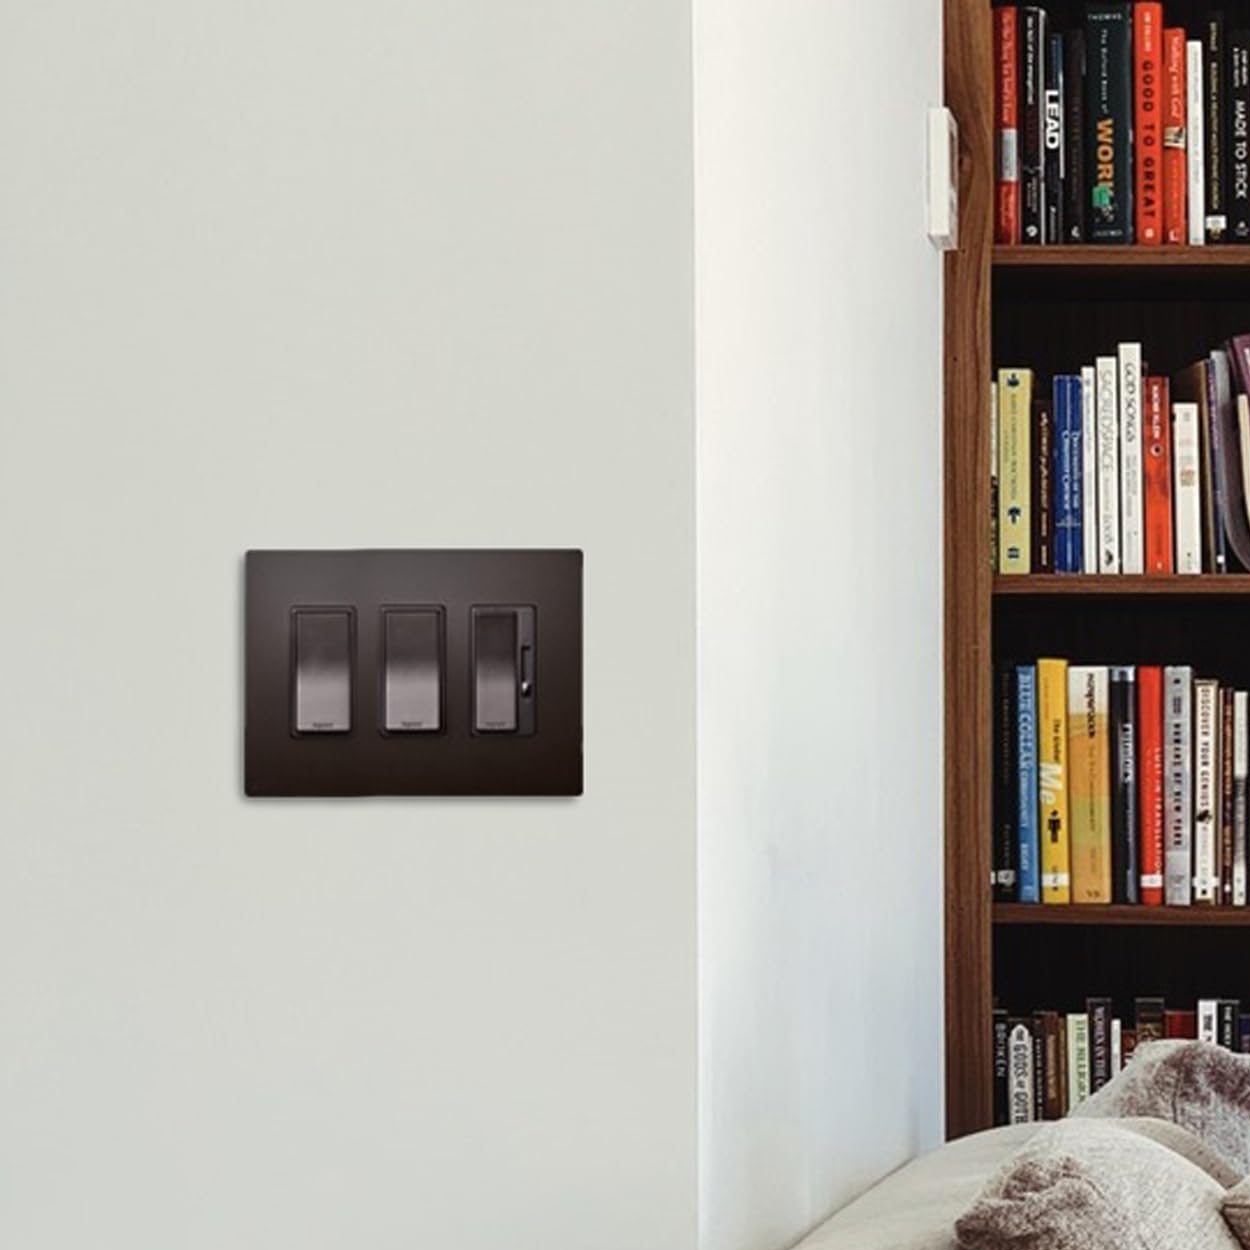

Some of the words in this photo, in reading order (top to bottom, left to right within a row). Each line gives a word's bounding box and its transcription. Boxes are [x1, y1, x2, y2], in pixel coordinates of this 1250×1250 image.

[1142, 60, 1155, 113] GOOD
[1045, 90, 1059, 149] LEAD
[1142, 124, 1155, 147] TO
[1234, 100, 1246, 137] MADE
[1234, 142, 1246, 160] TO
[1142, 157, 1156, 218] GREAT
[1234, 163, 1247, 198] STICK
[1124, 362, 1137, 394] GOD
[1124, 398, 1138, 443] SONGS
[1018, 674, 1031, 710] BLUE
[1201, 688, 1210, 736] DISCOVER
[1019, 713, 1032, 769] COLLAR
[1201, 741, 1210, 767] YOUR
[1040, 762, 1064, 805] Me
[1201, 769, 1210, 807] GENIUS
[995, 1022, 1008, 1077] BROKEN
[1013, 1043, 1028, 1077] GODS
